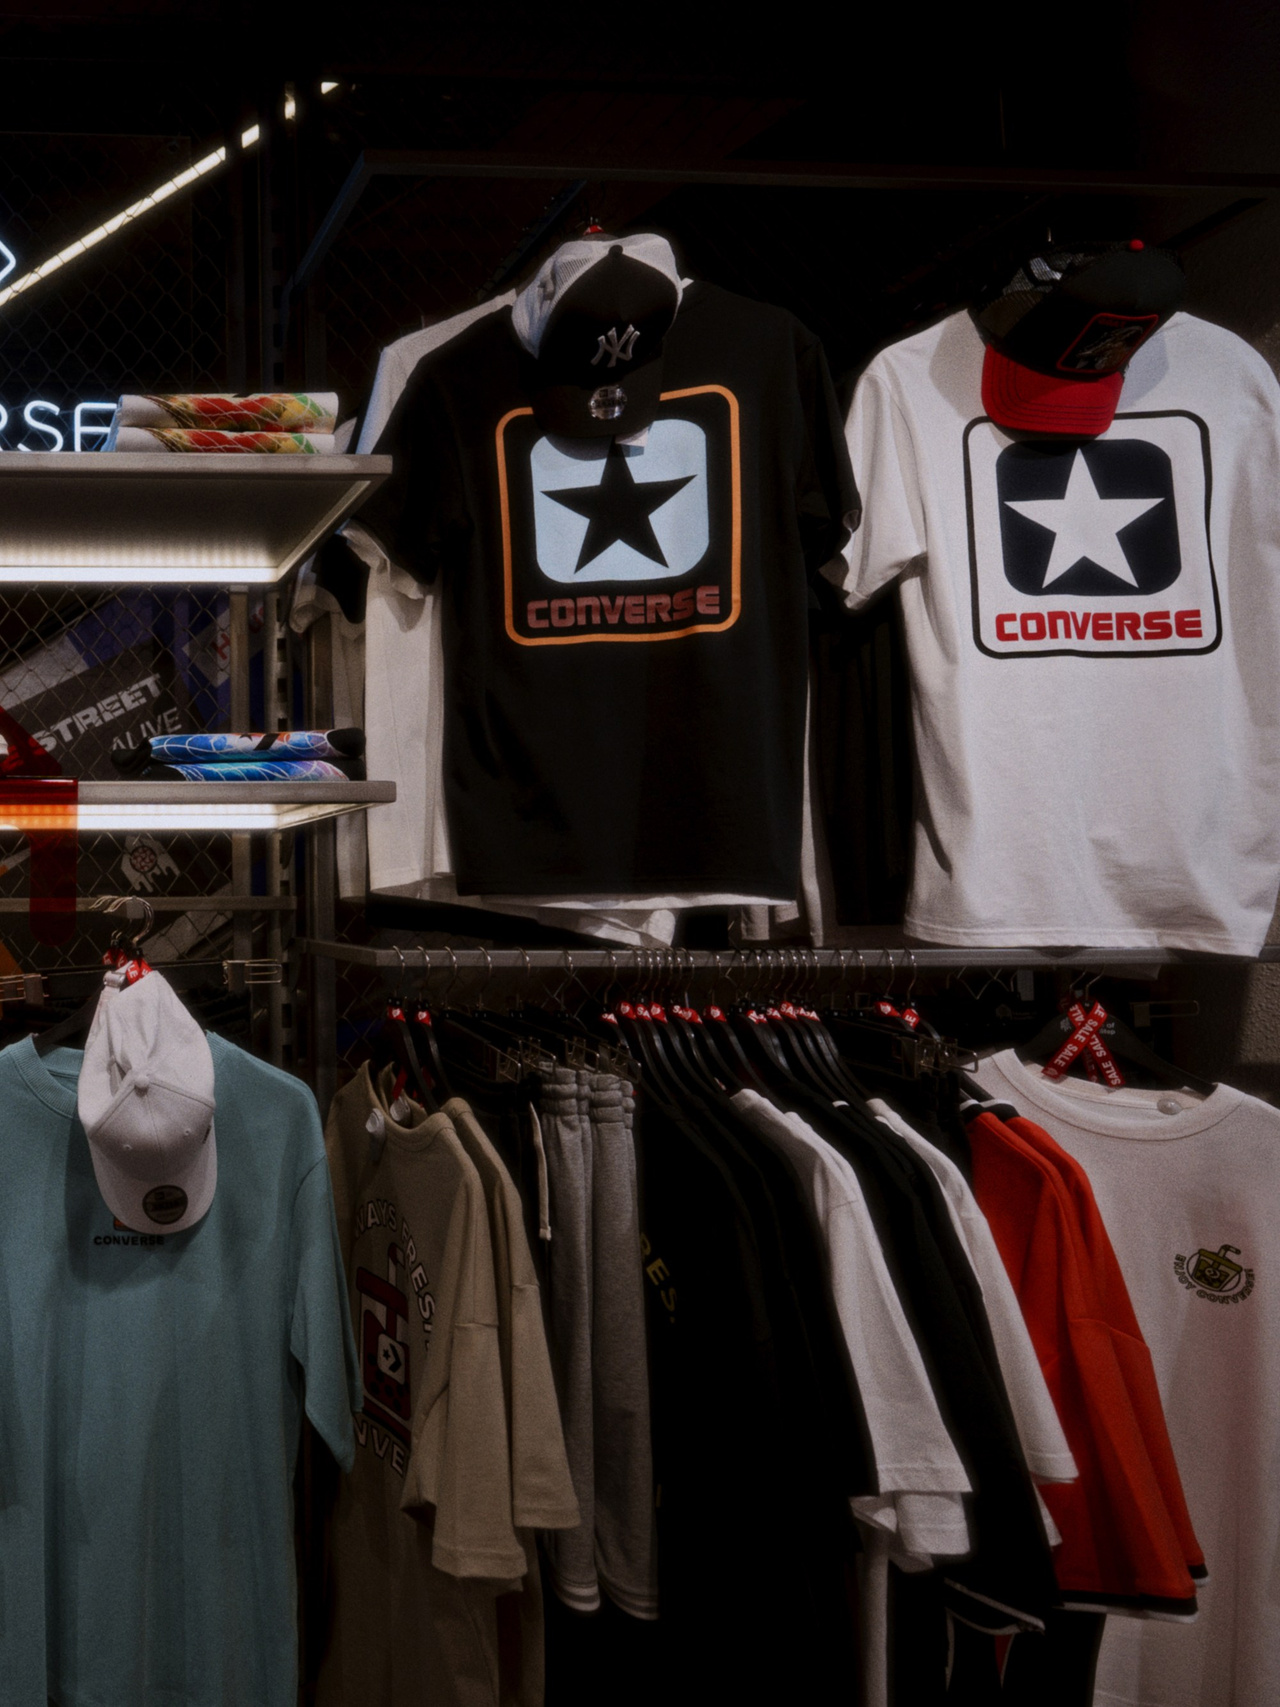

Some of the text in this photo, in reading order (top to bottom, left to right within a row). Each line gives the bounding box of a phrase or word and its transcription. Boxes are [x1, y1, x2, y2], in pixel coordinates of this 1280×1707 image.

[526, 585, 721, 629] CONVERSE
[995, 609, 1203, 642] CONVERSE
[30, 672, 162, 753] STREET
[1073, 1018, 1099, 1043] SALE
[1053, 1043, 1079, 1068] SALE
[1101, 1060, 1122, 1086] SALE
[94, 1235, 165, 1246] CONVERSE
